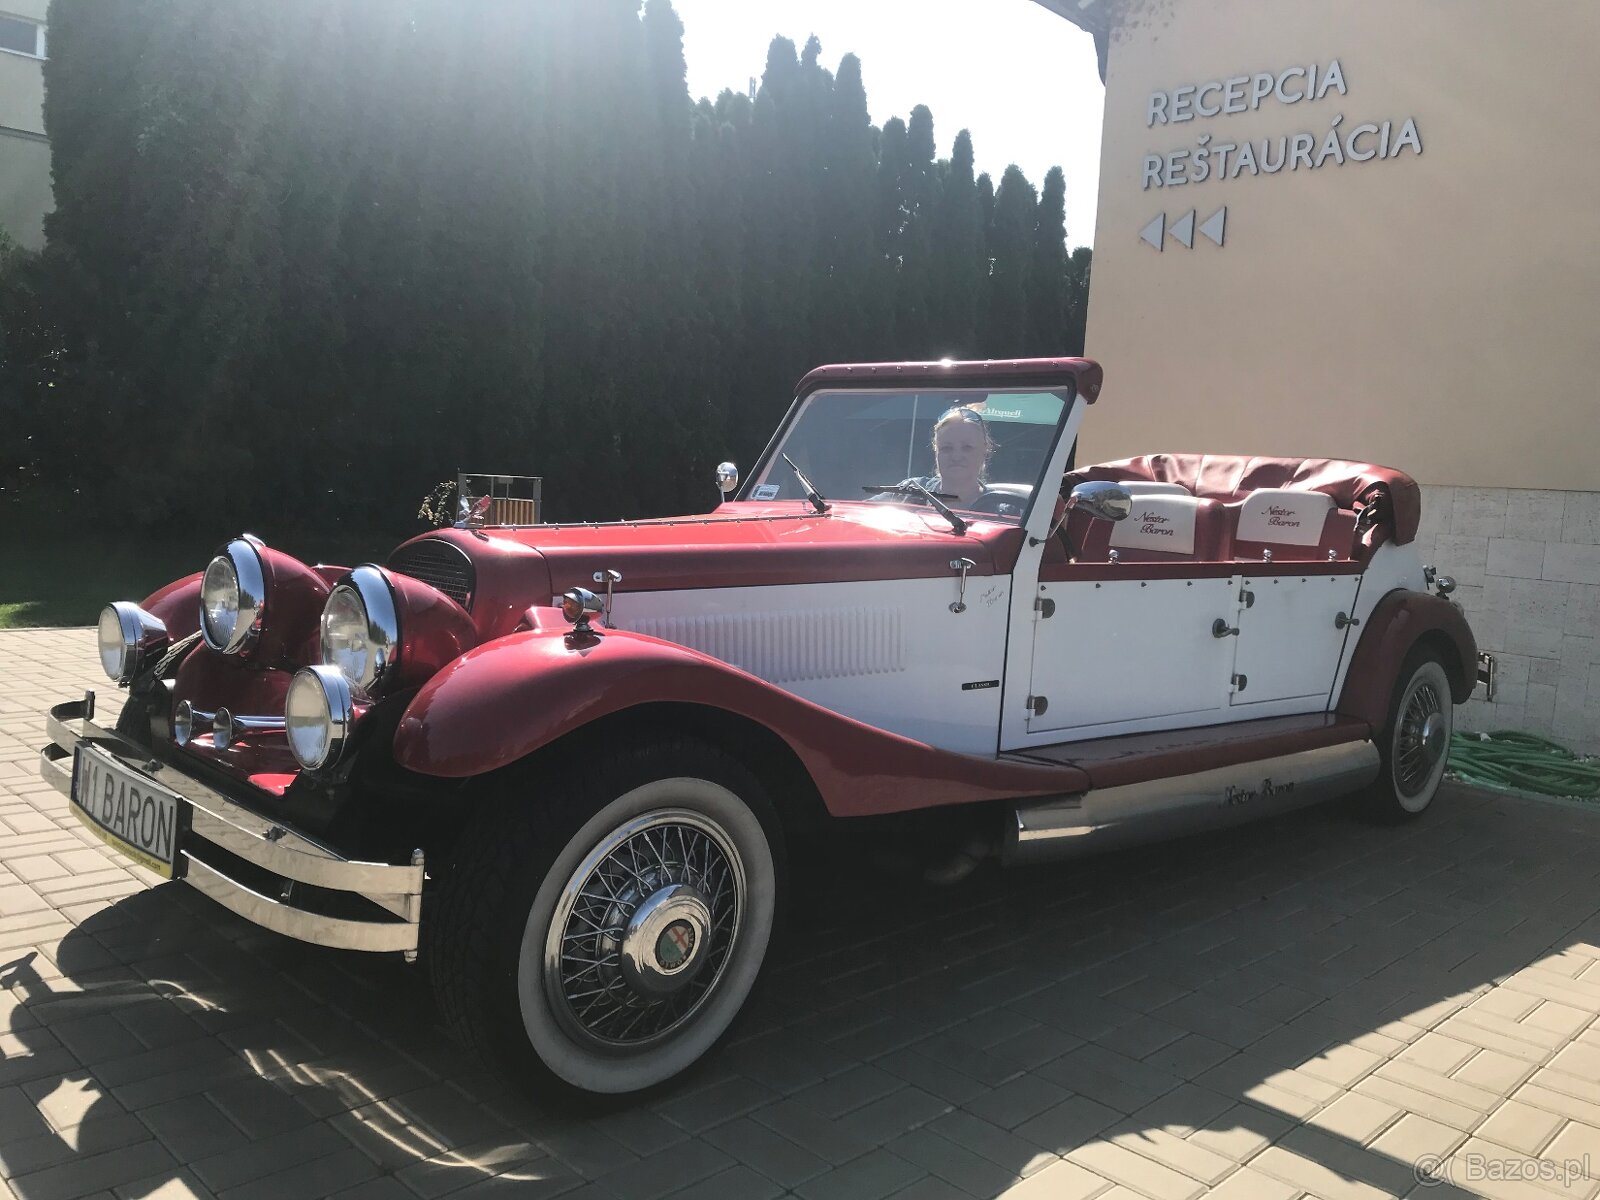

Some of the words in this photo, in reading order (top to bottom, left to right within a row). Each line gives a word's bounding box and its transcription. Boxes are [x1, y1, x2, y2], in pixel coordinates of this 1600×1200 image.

[1147, 59, 1347, 127] RECEPCIA
[1142, 114, 1422, 191] REŠTAURÁCIA
[1140, 523, 1174, 536] Baron
[1268, 516, 1300, 527] Baron
[102, 772, 174, 859] BARON
